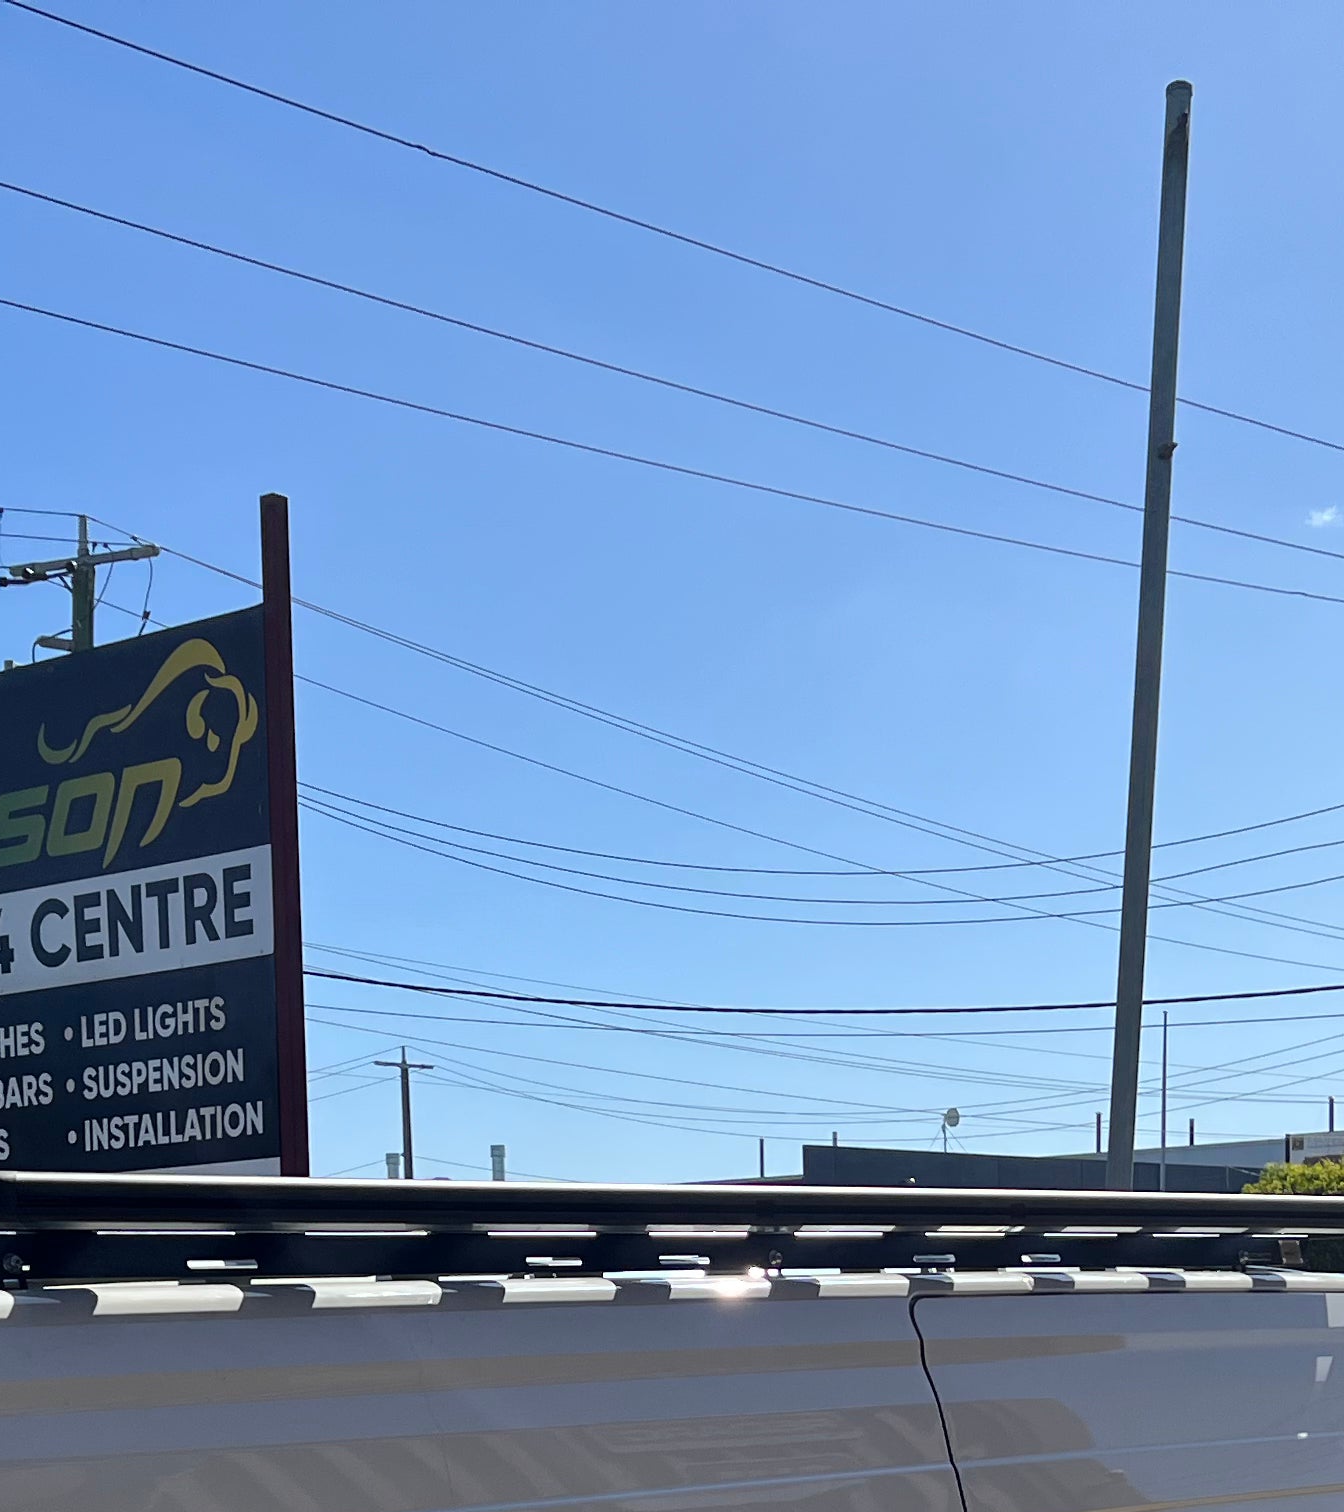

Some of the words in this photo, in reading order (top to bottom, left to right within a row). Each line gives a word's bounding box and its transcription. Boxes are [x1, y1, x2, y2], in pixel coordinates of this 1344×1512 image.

[30, 863, 254, 968] CENTRE
[81, 1011, 127, 1048] LED
[134, 996, 226, 1041] LIGHTS
[82, 1048, 244, 1100] SUSPENSION
[84, 1100, 264, 1152] INSTALLATION
